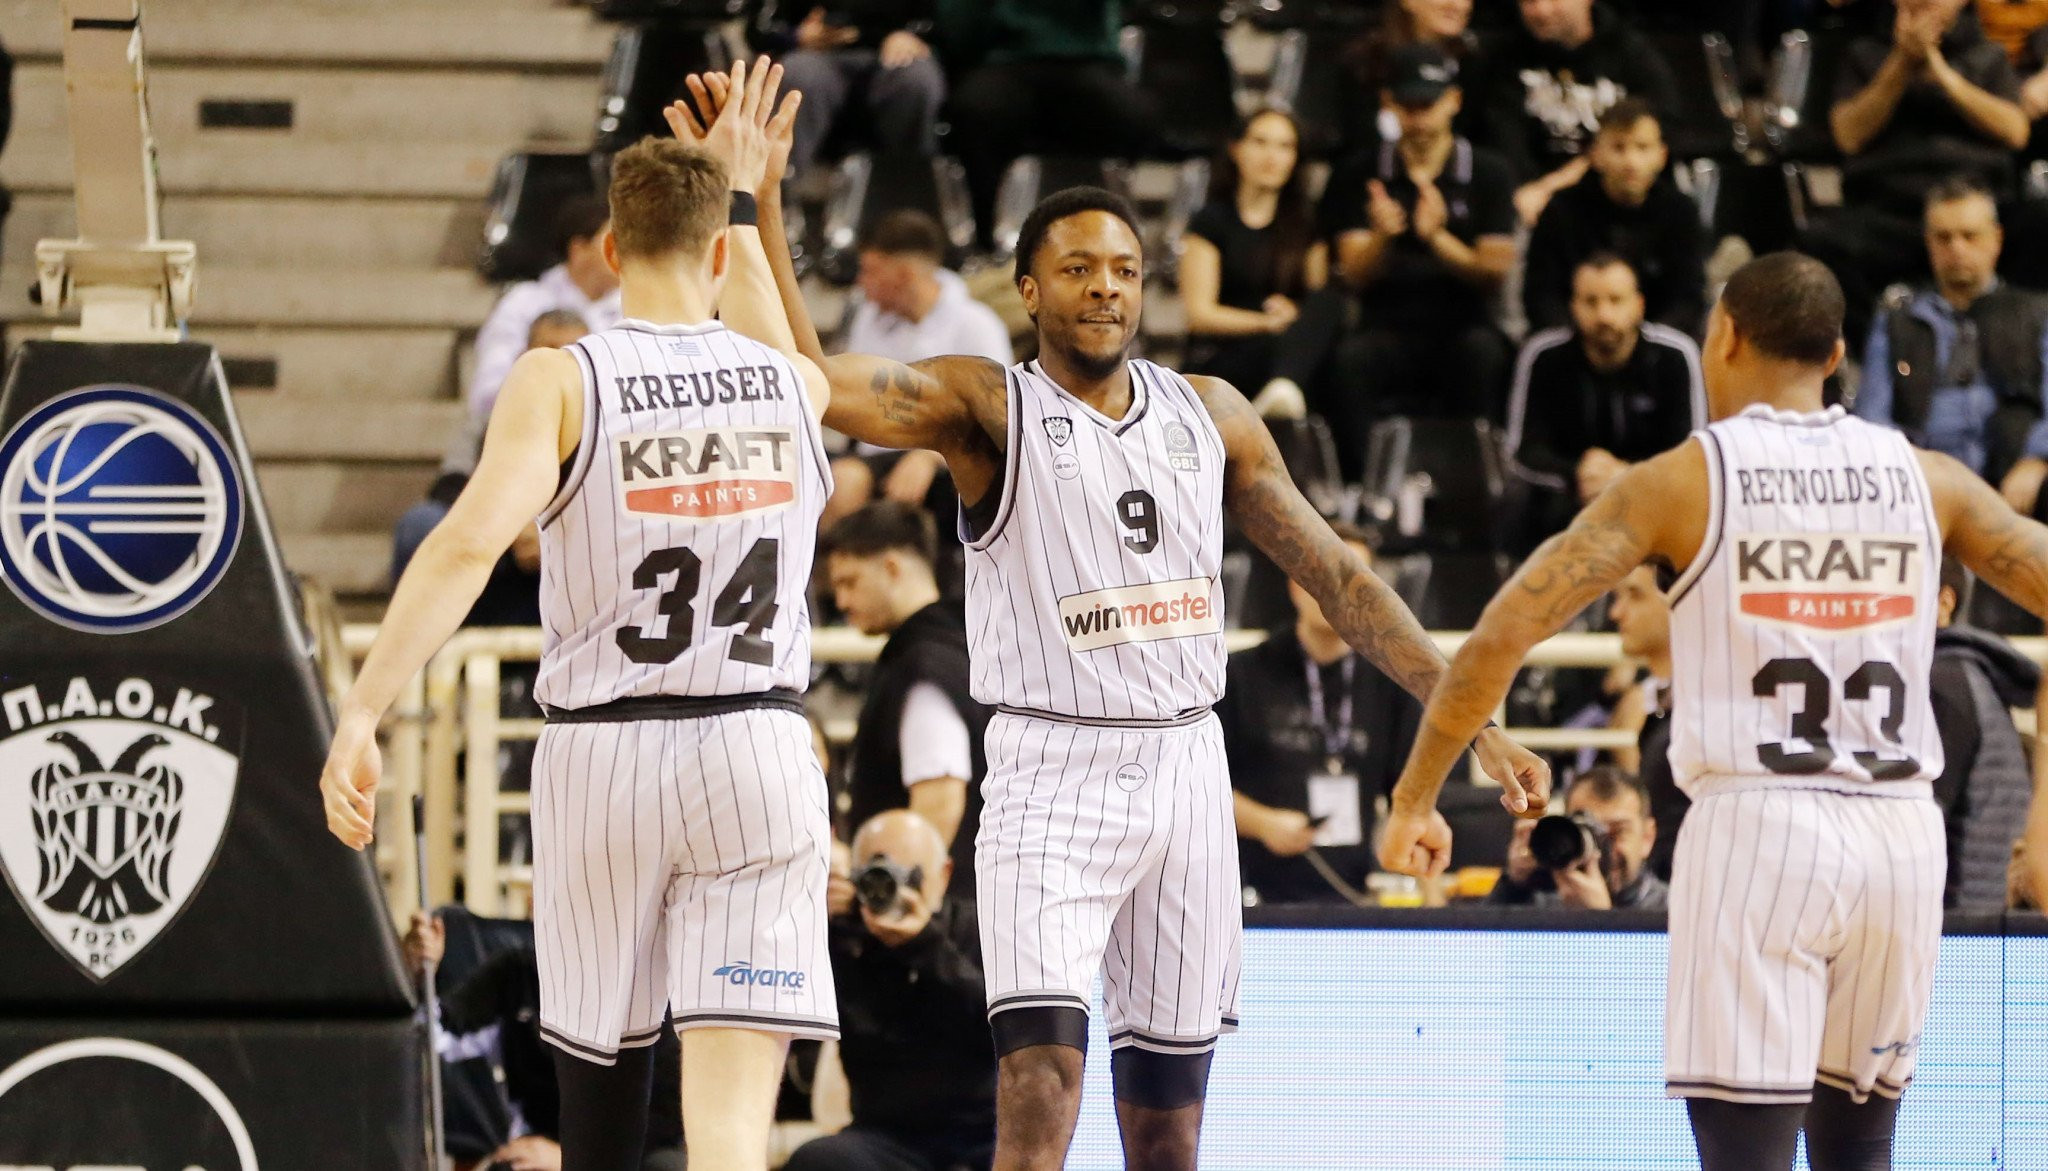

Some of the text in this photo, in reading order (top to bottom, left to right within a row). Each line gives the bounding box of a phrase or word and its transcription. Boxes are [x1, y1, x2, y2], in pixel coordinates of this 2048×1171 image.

[614, 364, 785, 414] KREUSER
[619, 431, 791, 482] KRAFT
[1171, 457, 1199, 470] GBL
[672, 487, 757, 508] PAINTS
[1737, 466, 1916, 511] REYNOLDS JR
[1116, 489, 1159, 554] 9
[1737, 539, 1918, 583] KRAFT
[615, 538, 779, 667] 34
[1787, 598, 1880, 618] PAINTS
[1752, 657, 1921, 781] 33
[72, 927, 136, 948] 1926
[728, 966, 805, 988] avance
